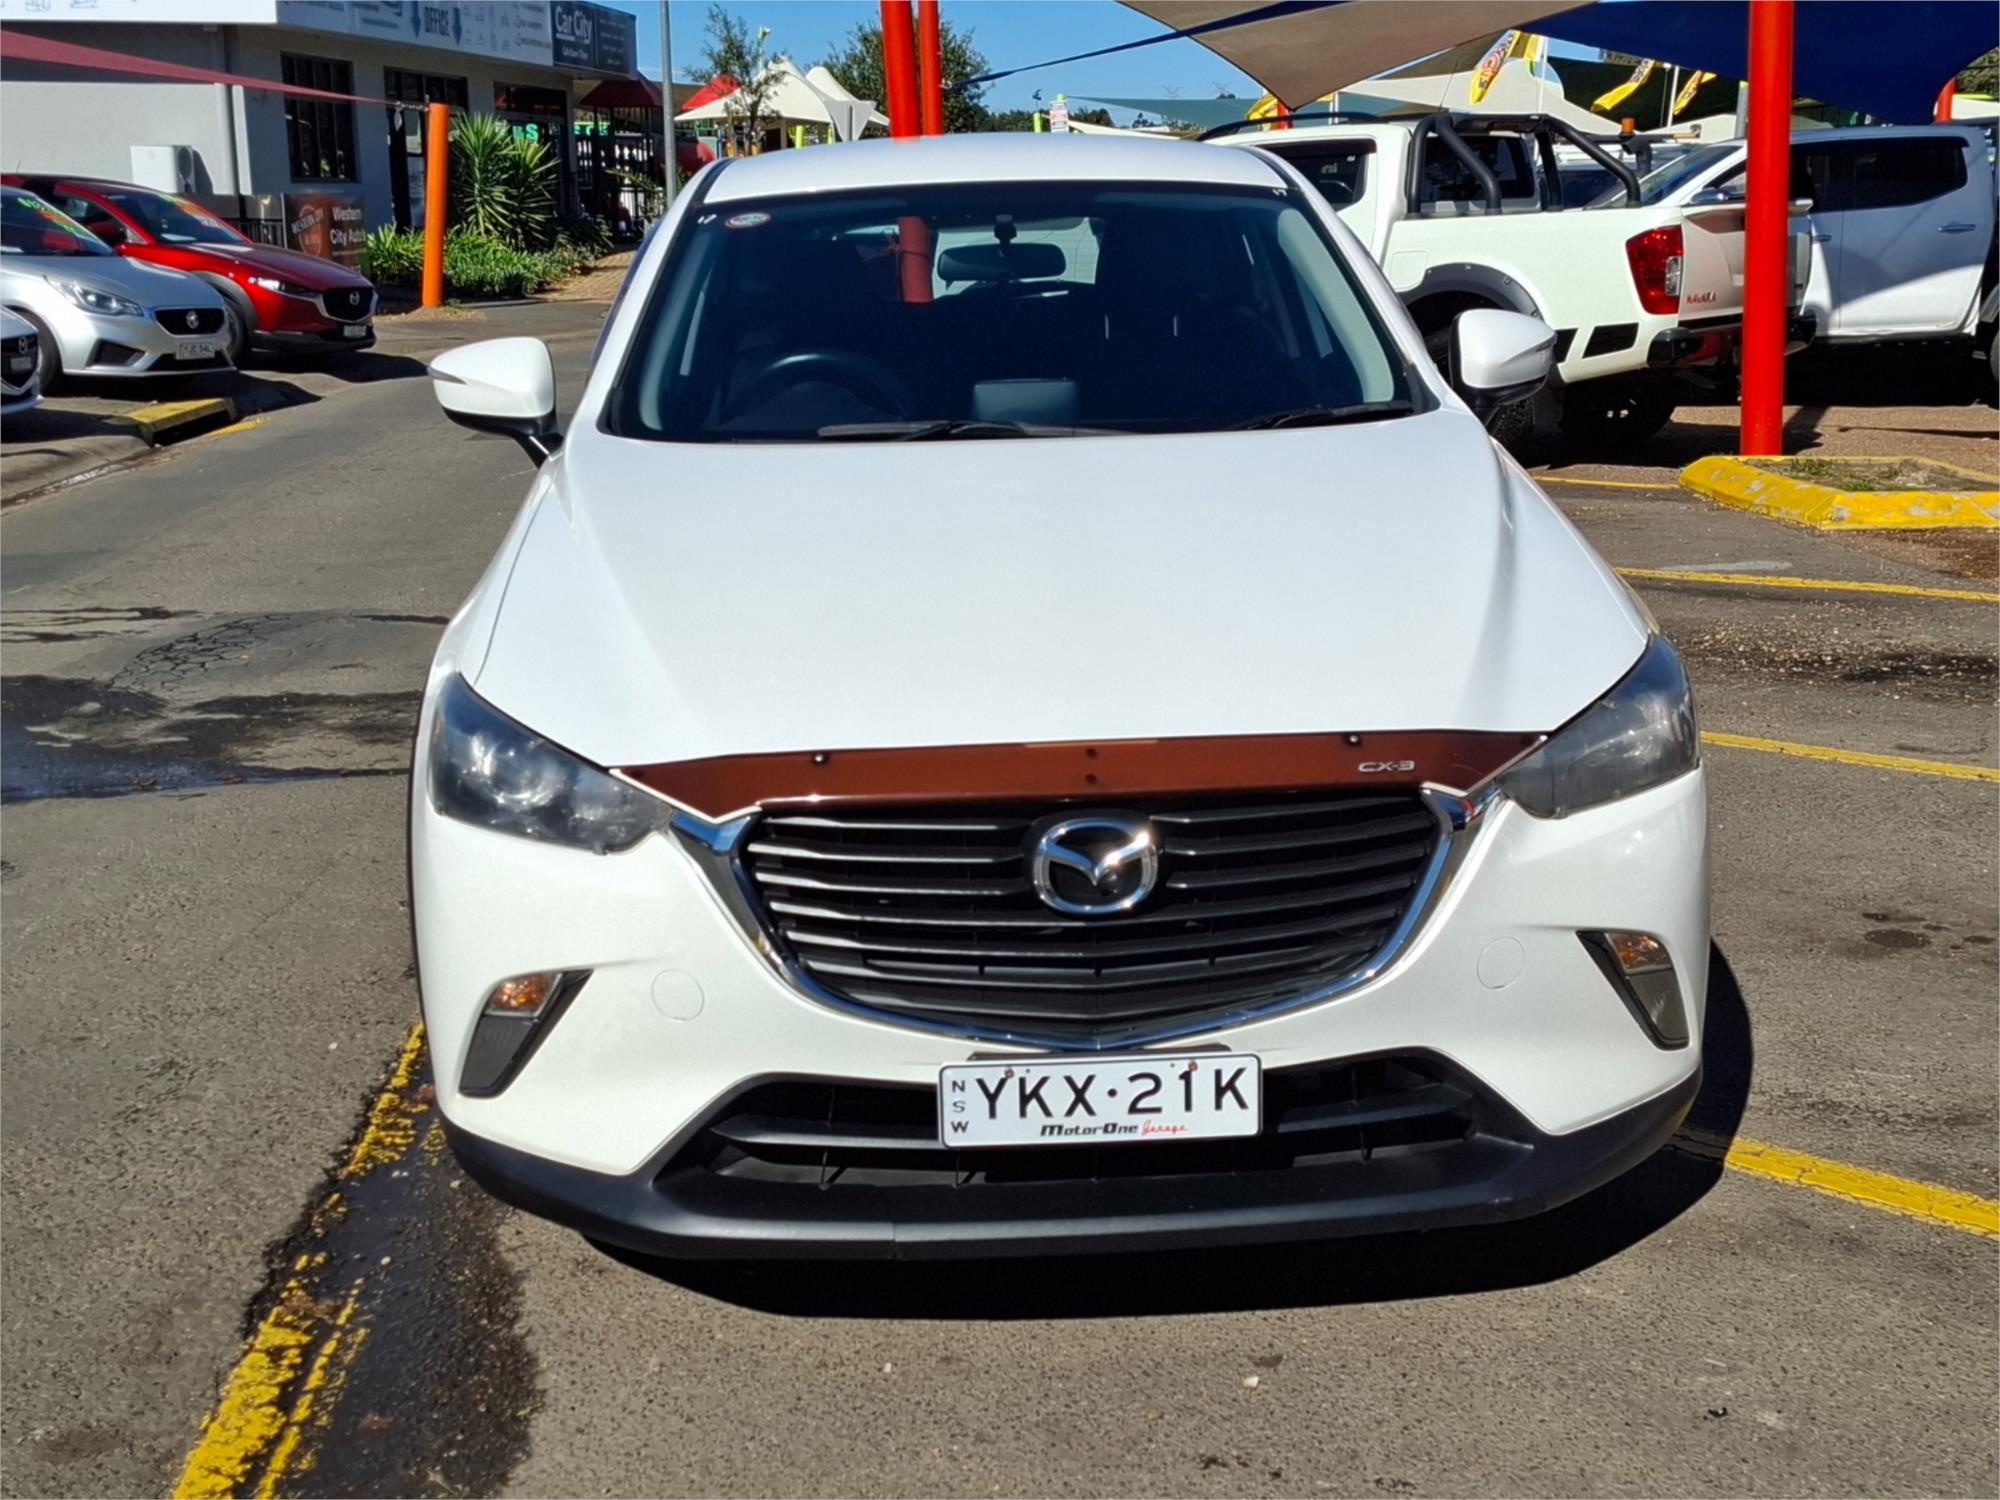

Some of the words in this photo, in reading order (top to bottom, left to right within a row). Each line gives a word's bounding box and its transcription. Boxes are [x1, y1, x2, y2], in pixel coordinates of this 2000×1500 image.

[424, 6, 450, 37] OFFICE
[555, 5, 573, 34] Car
[574, 10, 593, 45] City
[332, 206, 362, 221] Western
[330, 228, 348, 247] City
[1686, 291, 1717, 305] NAVARA
[1358, 760, 1416, 772] CX-3
[1040, 1122, 1139, 1137] MotorOne
[1140, 1119, 1188, 1136] Garage
